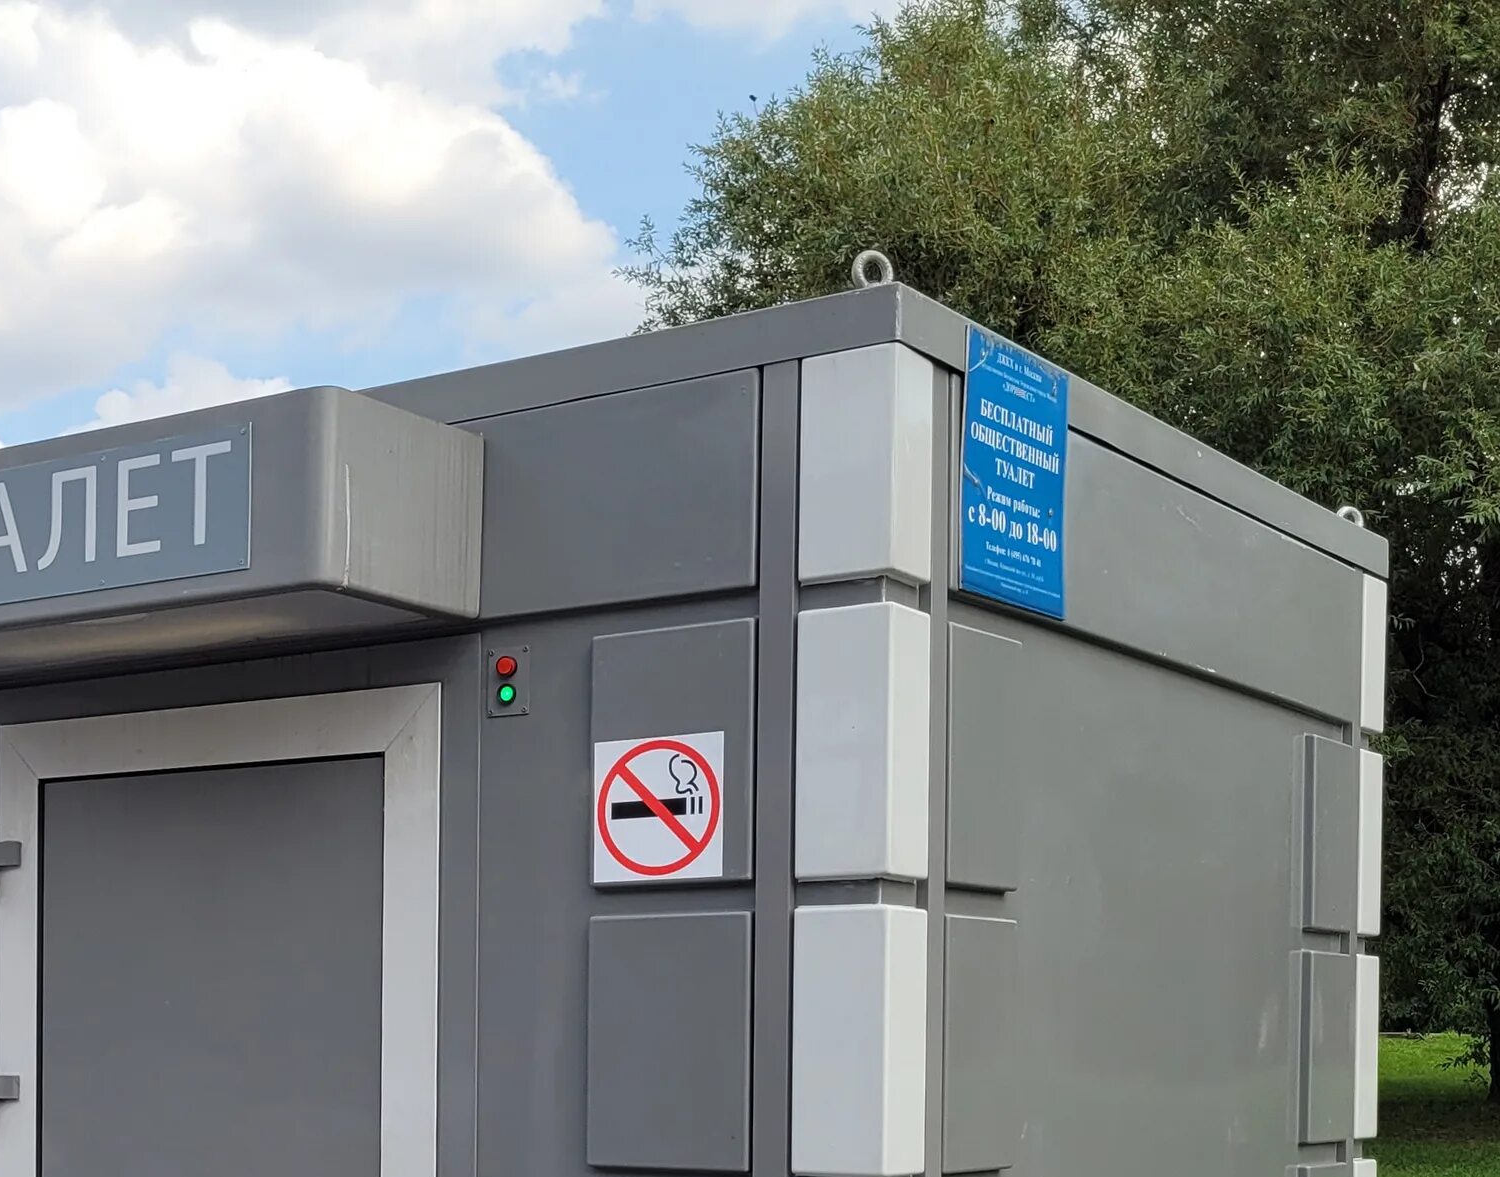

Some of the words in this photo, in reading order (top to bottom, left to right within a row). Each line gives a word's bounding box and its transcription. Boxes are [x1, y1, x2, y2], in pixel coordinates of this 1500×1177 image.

[980, 397, 1053, 447] БЕСПЛАТНЫЙ
[970, 421, 1059, 475] ОБЩЕСТВЕННЫЙ
[995, 457, 1035, 489] ТУАЛЕТ
[987, 485, 1011, 507] Режим
[1013, 499, 1040, 519] работы:
[968, 505, 975, 523] с
[978, 503, 1006, 534] 8-00
[1008, 520, 1023, 540] до
[1026, 521, 1057, 552] 18-00
